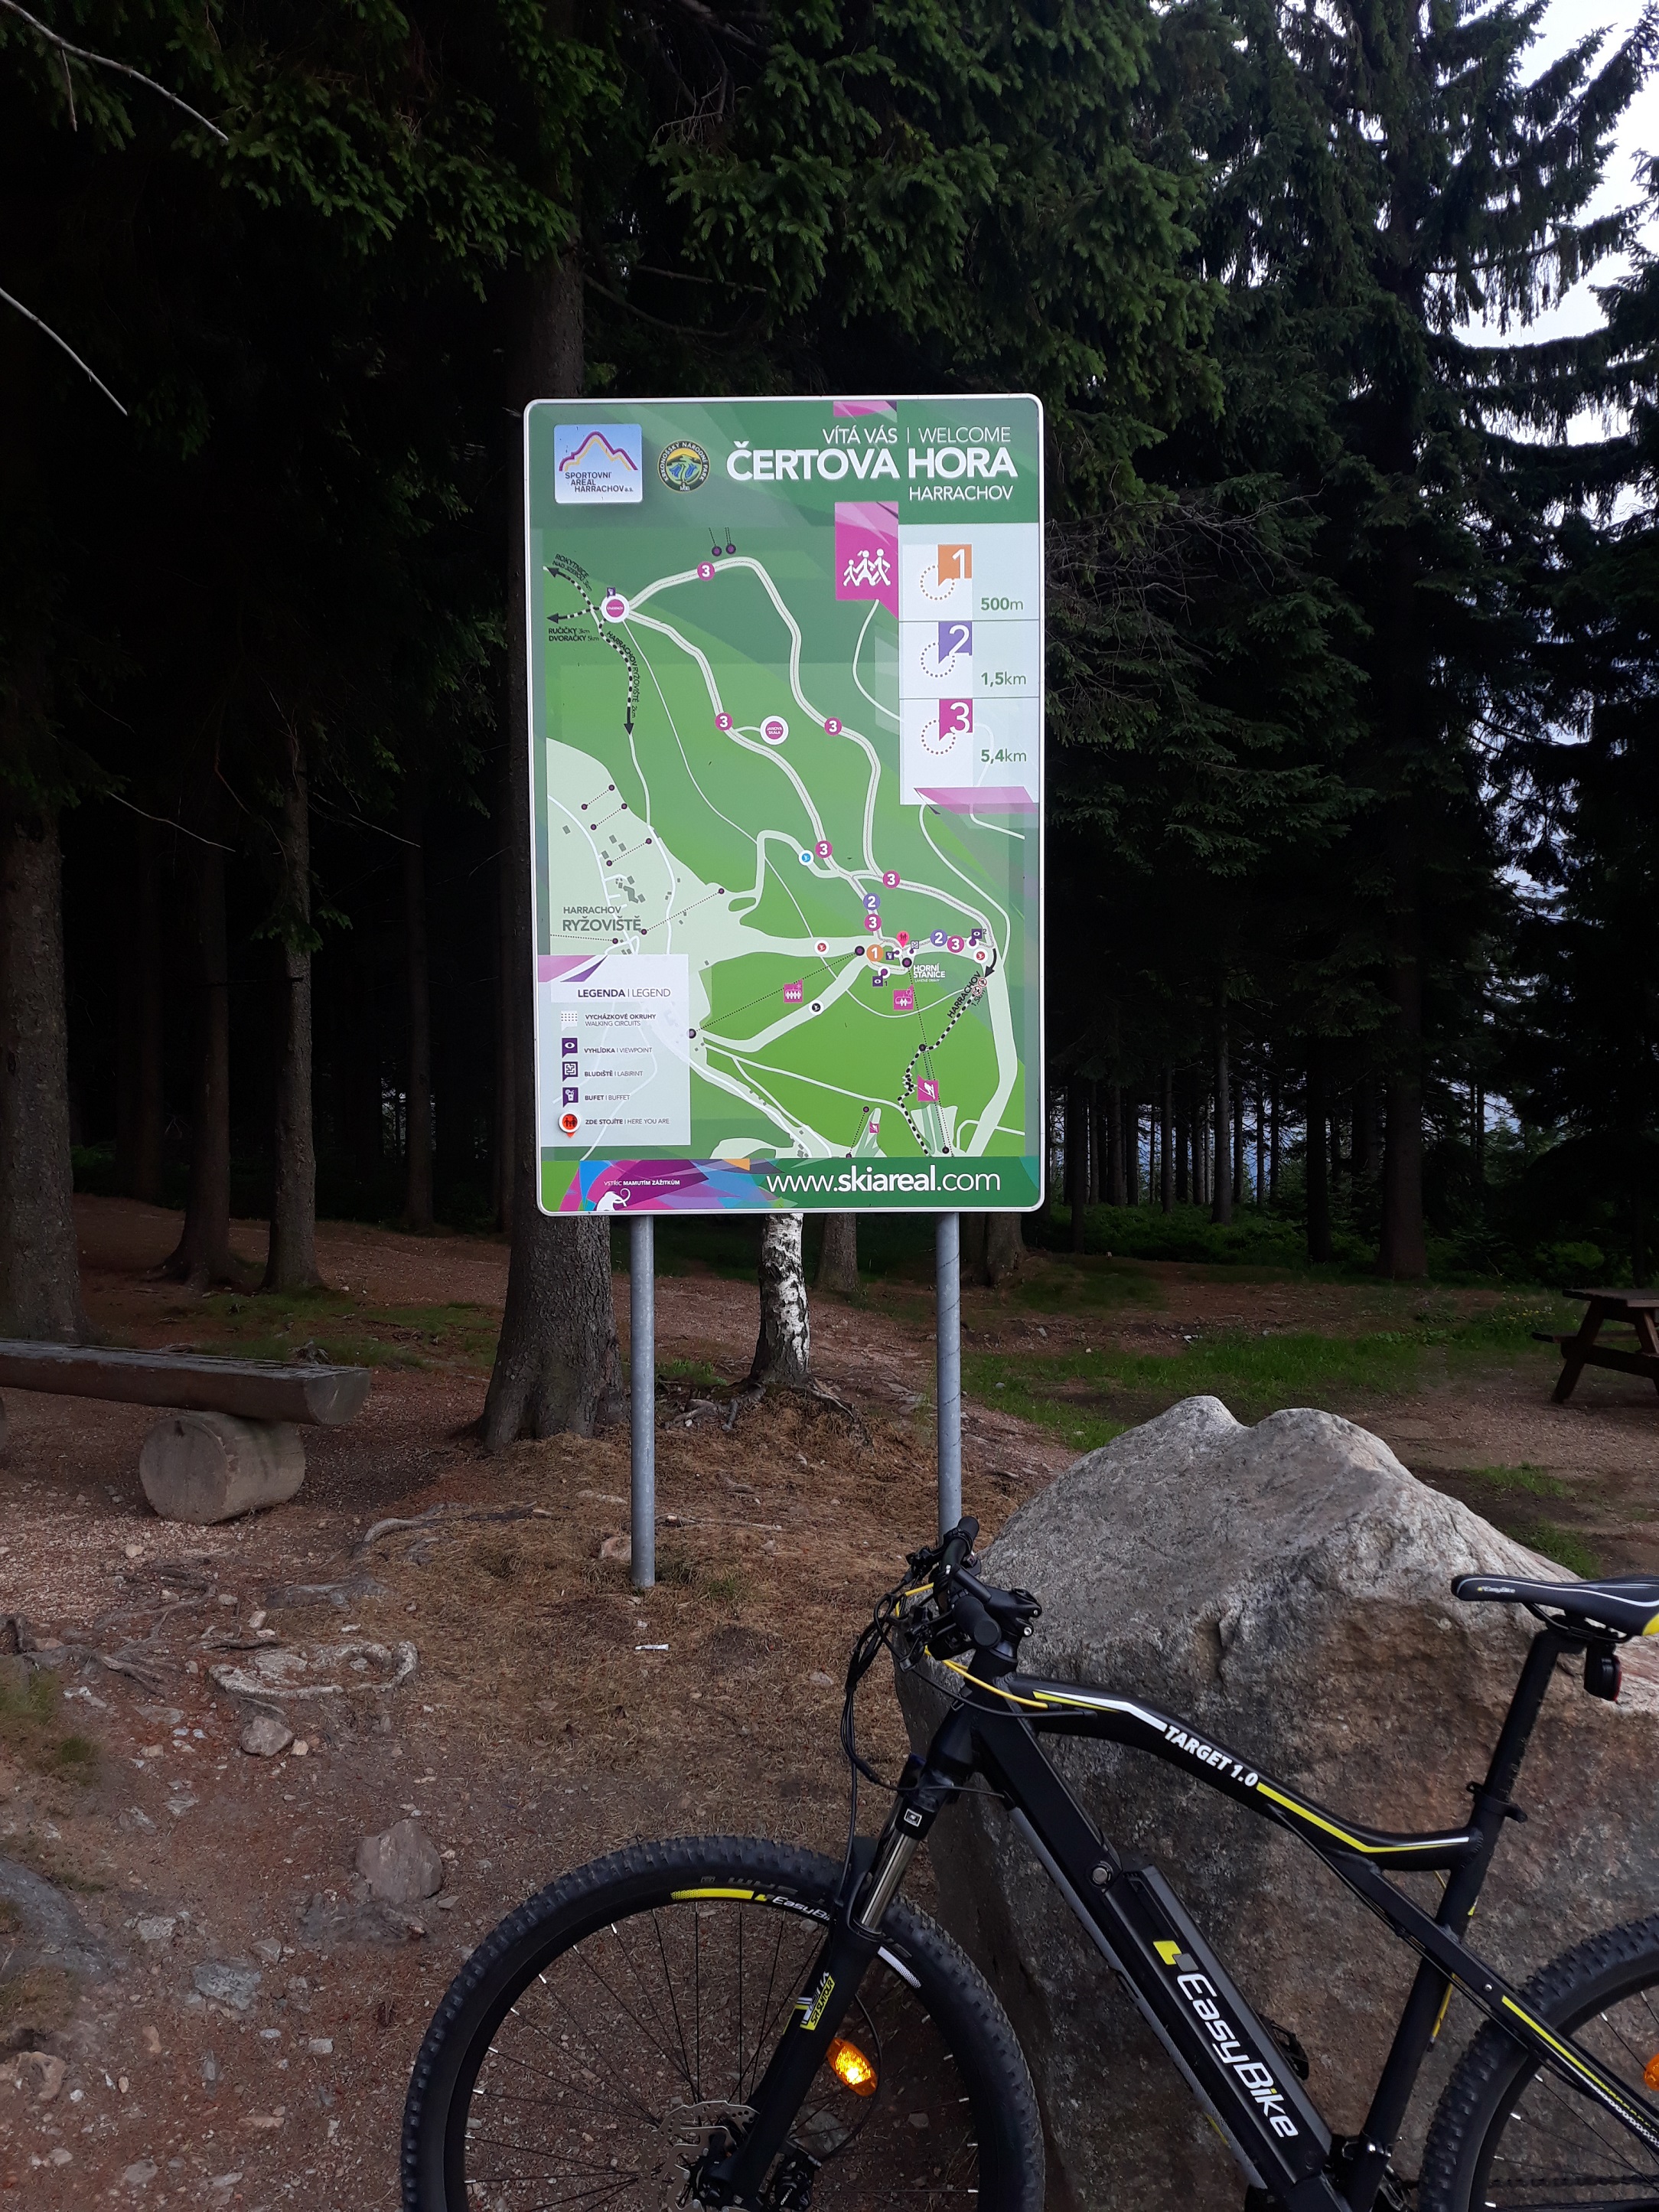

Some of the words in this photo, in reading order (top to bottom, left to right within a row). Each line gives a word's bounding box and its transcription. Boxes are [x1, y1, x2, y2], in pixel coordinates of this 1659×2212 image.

[823, 425, 860, 444] VÍTÁ
[864, 425, 898, 444] VÁS
[918, 426, 1011, 442] WELCOME
[726, 441, 900, 481] ČERTOVA
[908, 447, 1018, 478] HORA
[699, 464, 708, 481] PARK
[909, 485, 1013, 501] HARRACHOV
[702, 565, 710, 577] 3
[952, 548, 966, 579] 1
[980, 597, 1024, 611] 500m
[949, 624, 971, 656] 2
[606, 630, 637, 667] HARRACHOV
[980, 671, 1027, 687] 1,5km
[719, 716, 728, 728] 3
[950, 701, 971, 733] 3
[829, 721, 837, 732] 3
[980, 749, 1028, 765] 5,4km
[820, 843, 828, 855] 3
[887, 873, 896, 886] 3
[867, 896, 876, 908] 2
[562, 906, 621, 915] HARRACHOV
[562, 916, 641, 931] RYŽOVIŠTĚ
[869, 916, 877, 928] 3
[934, 931, 943, 944] 2
[951, 938, 960, 951] 3
[913, 962, 940, 971] HORNÍ
[578, 989, 625, 997] LEGENDA
[632, 988, 671, 997] LEGEND
[947, 971, 982, 1019] HARRACHOV
[766, 1164, 1001, 1192] www.skiareal.com
[1164, 1724, 1233, 1771] TARGET
[1230, 1763, 1259, 1787] 1.0
[771, 1896, 833, 1922] EasyBi
[1176, 1973, 1299, 2138] EasyBike
